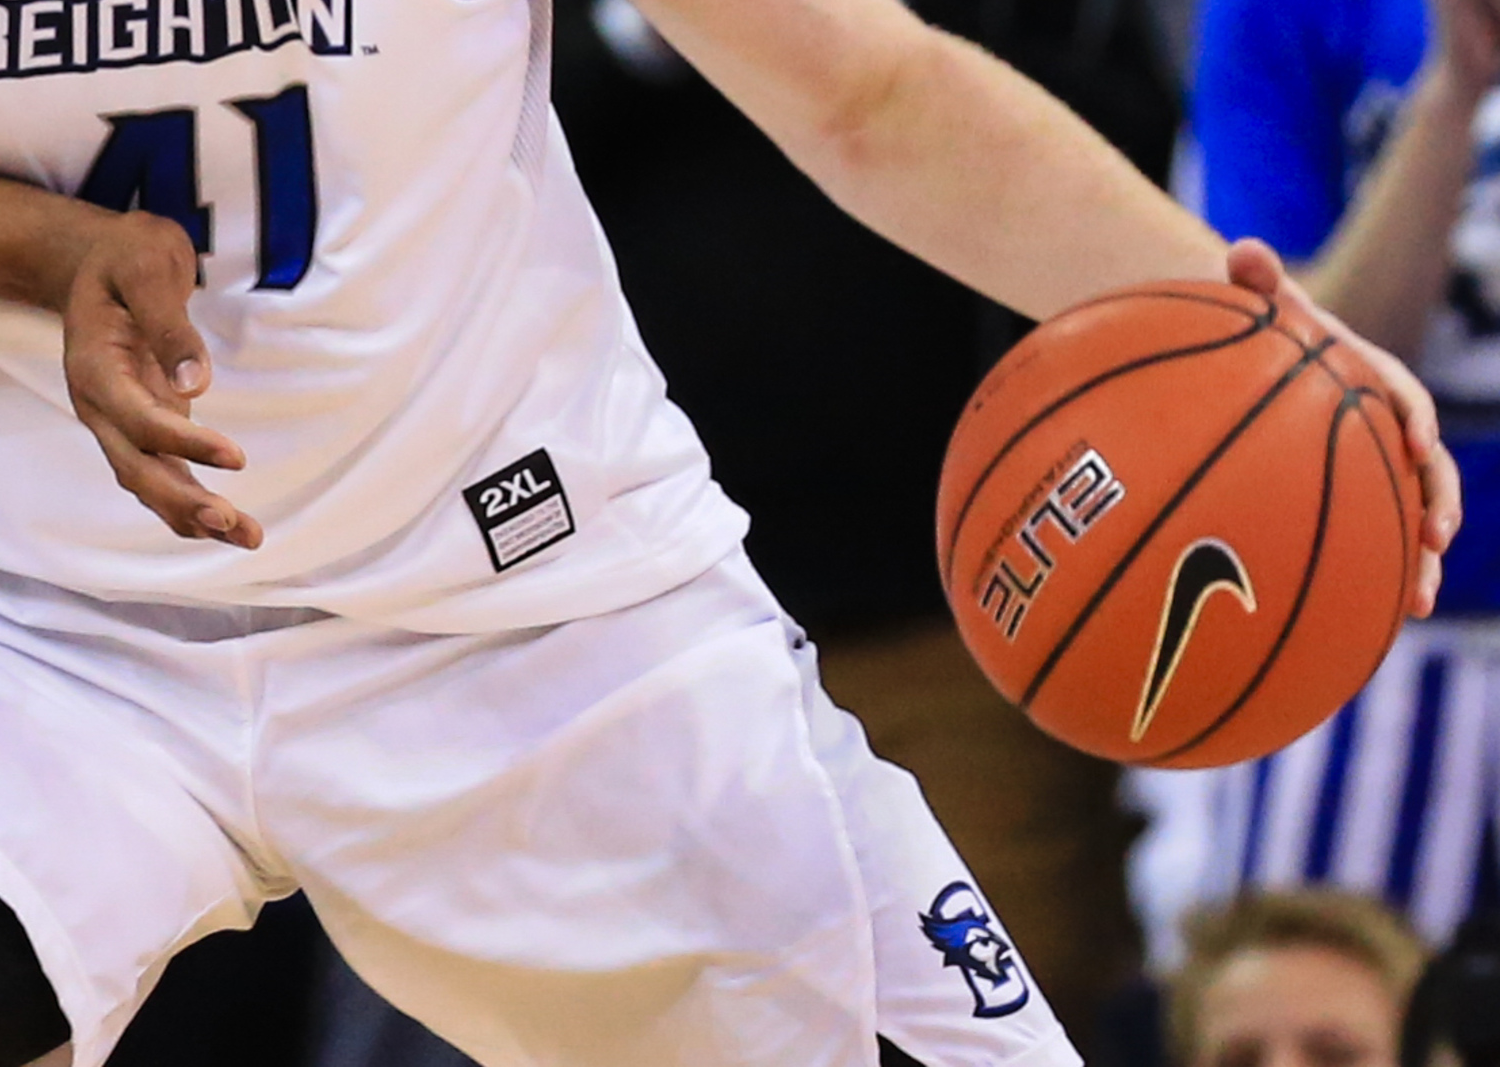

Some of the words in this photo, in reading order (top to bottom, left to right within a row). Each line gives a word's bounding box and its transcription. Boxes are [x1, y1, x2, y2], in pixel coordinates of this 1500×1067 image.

[77, 84, 319, 292] 41
[480, 468, 551, 518] 2XL
[979, 449, 1126, 644] ELITE
